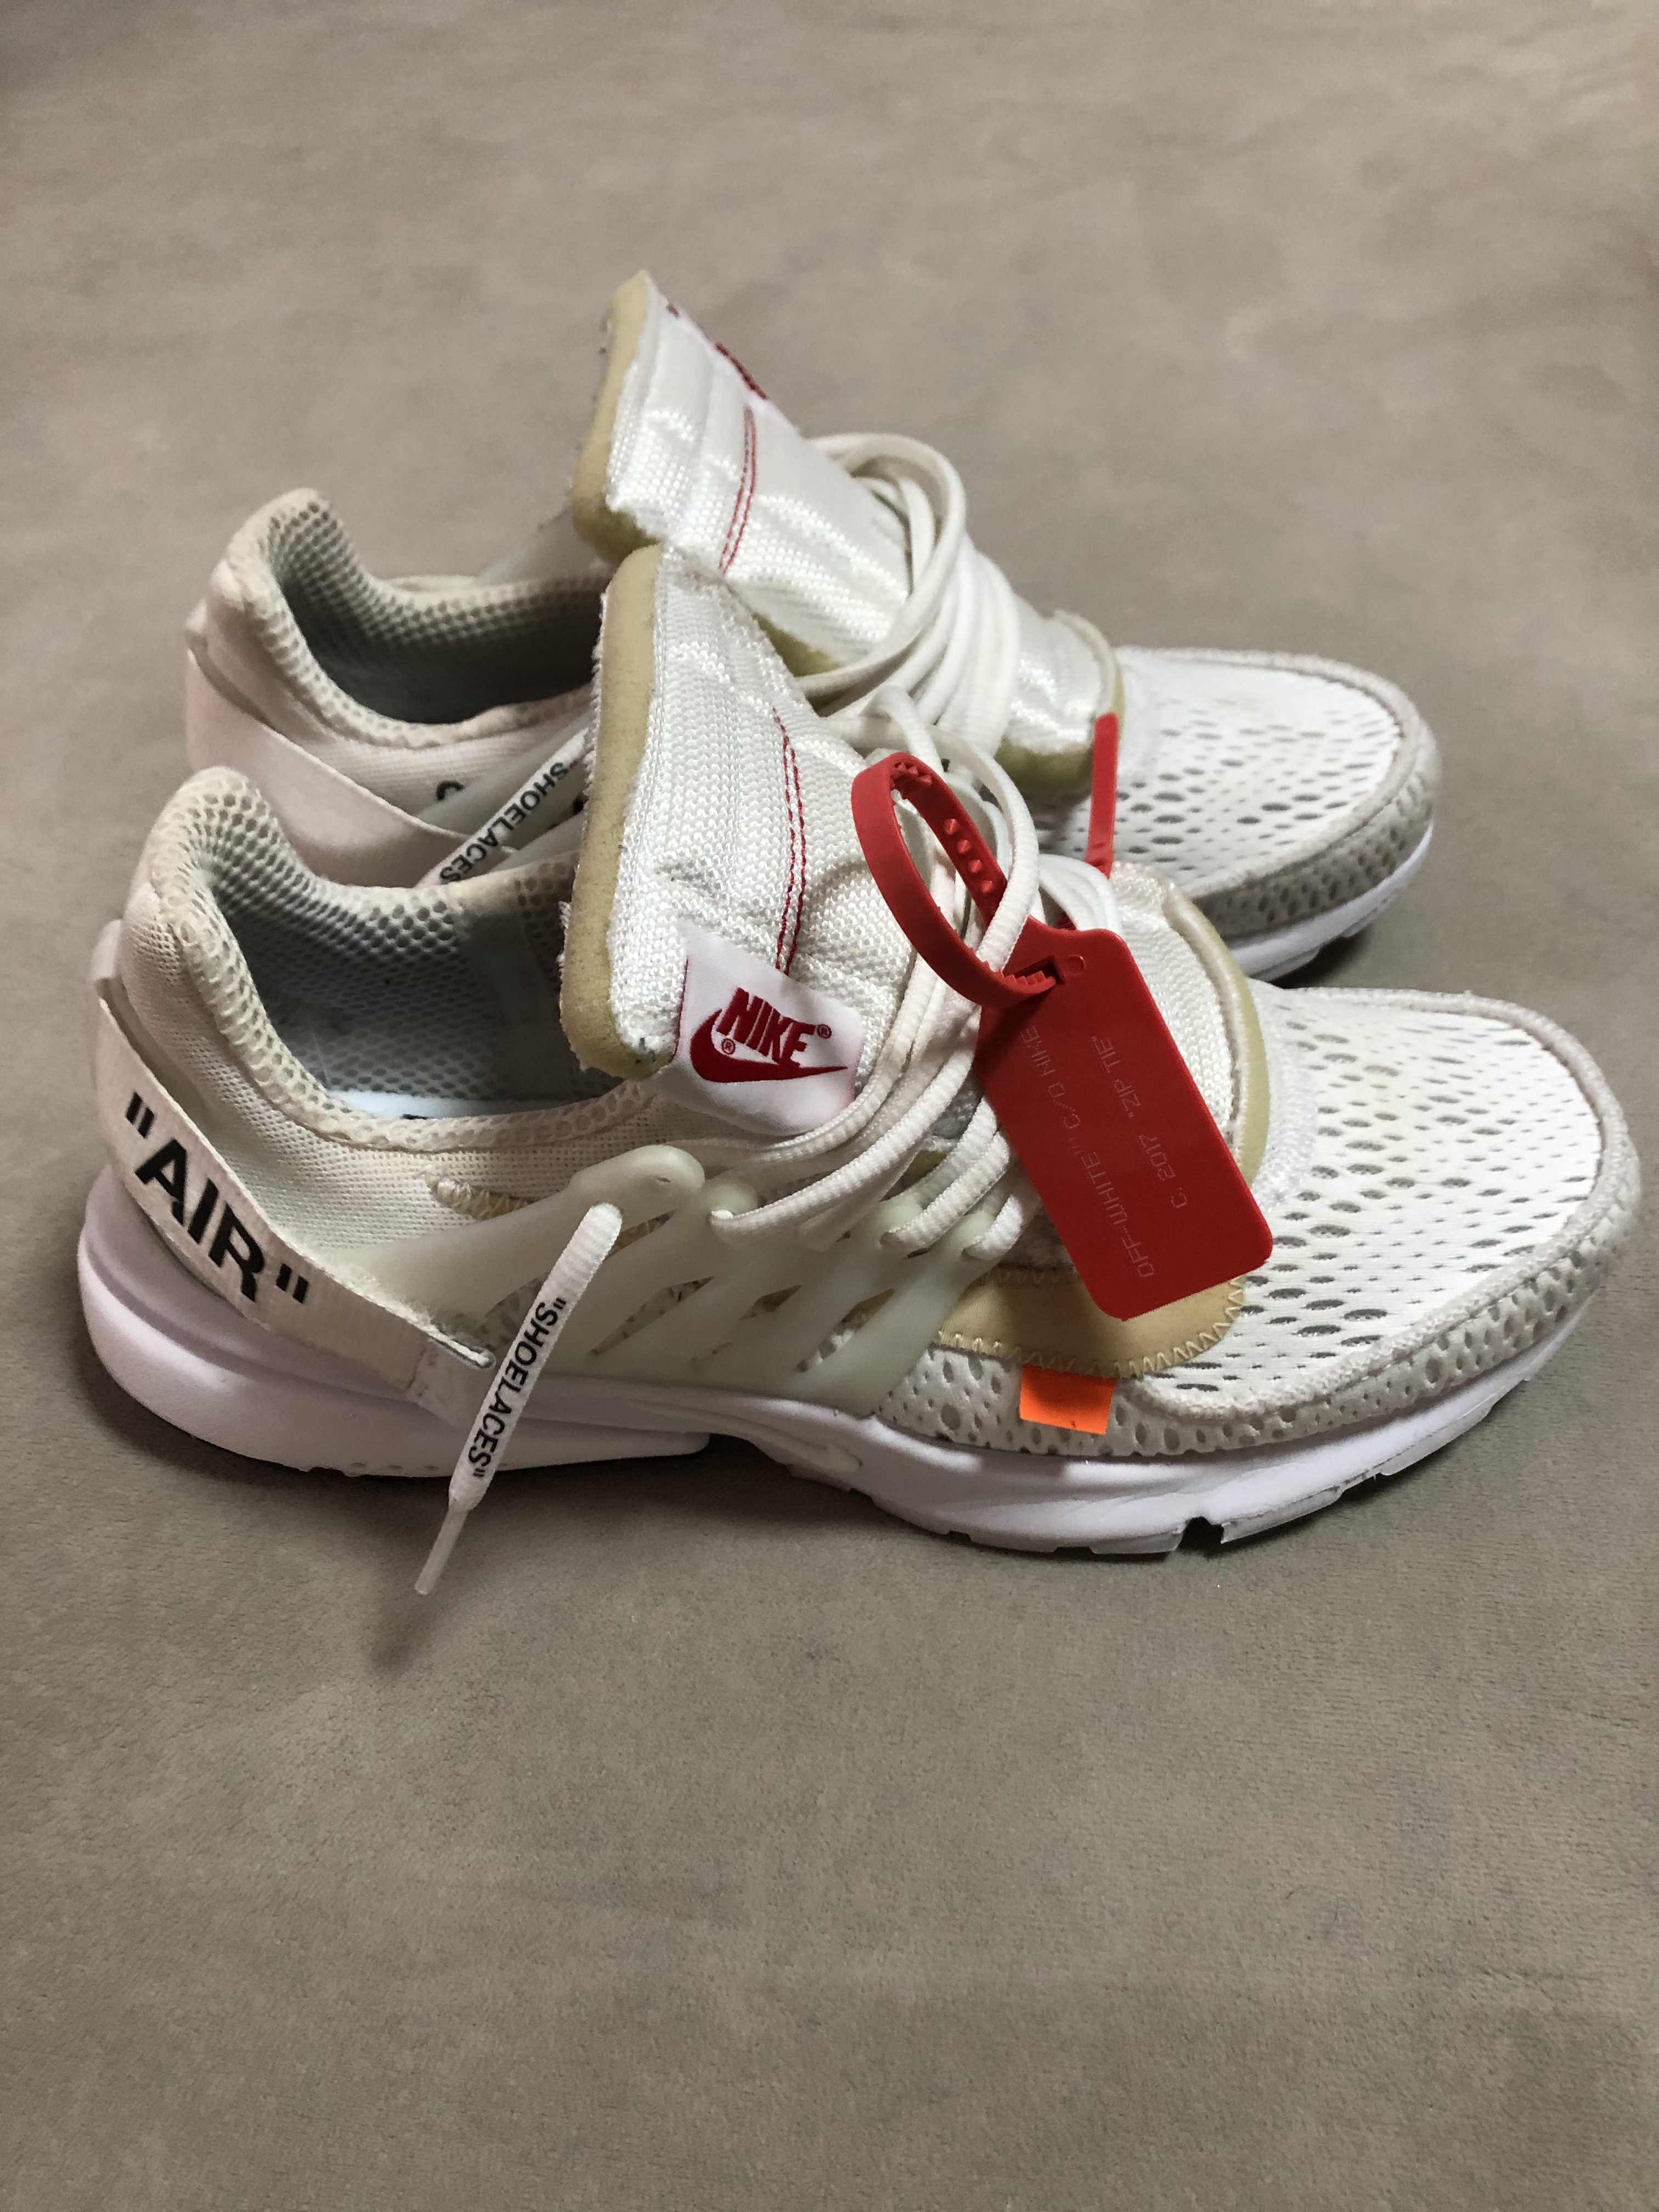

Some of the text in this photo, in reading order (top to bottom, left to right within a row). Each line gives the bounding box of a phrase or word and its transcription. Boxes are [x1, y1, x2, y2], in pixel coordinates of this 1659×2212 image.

[1020, 1025, 1056, 1076] NIKE
[126, 1092, 309, 1304] "AIR"
[1138, 1134, 1176, 1181] 2017
[468, 1297, 567, 1479] "SHOELACES"
